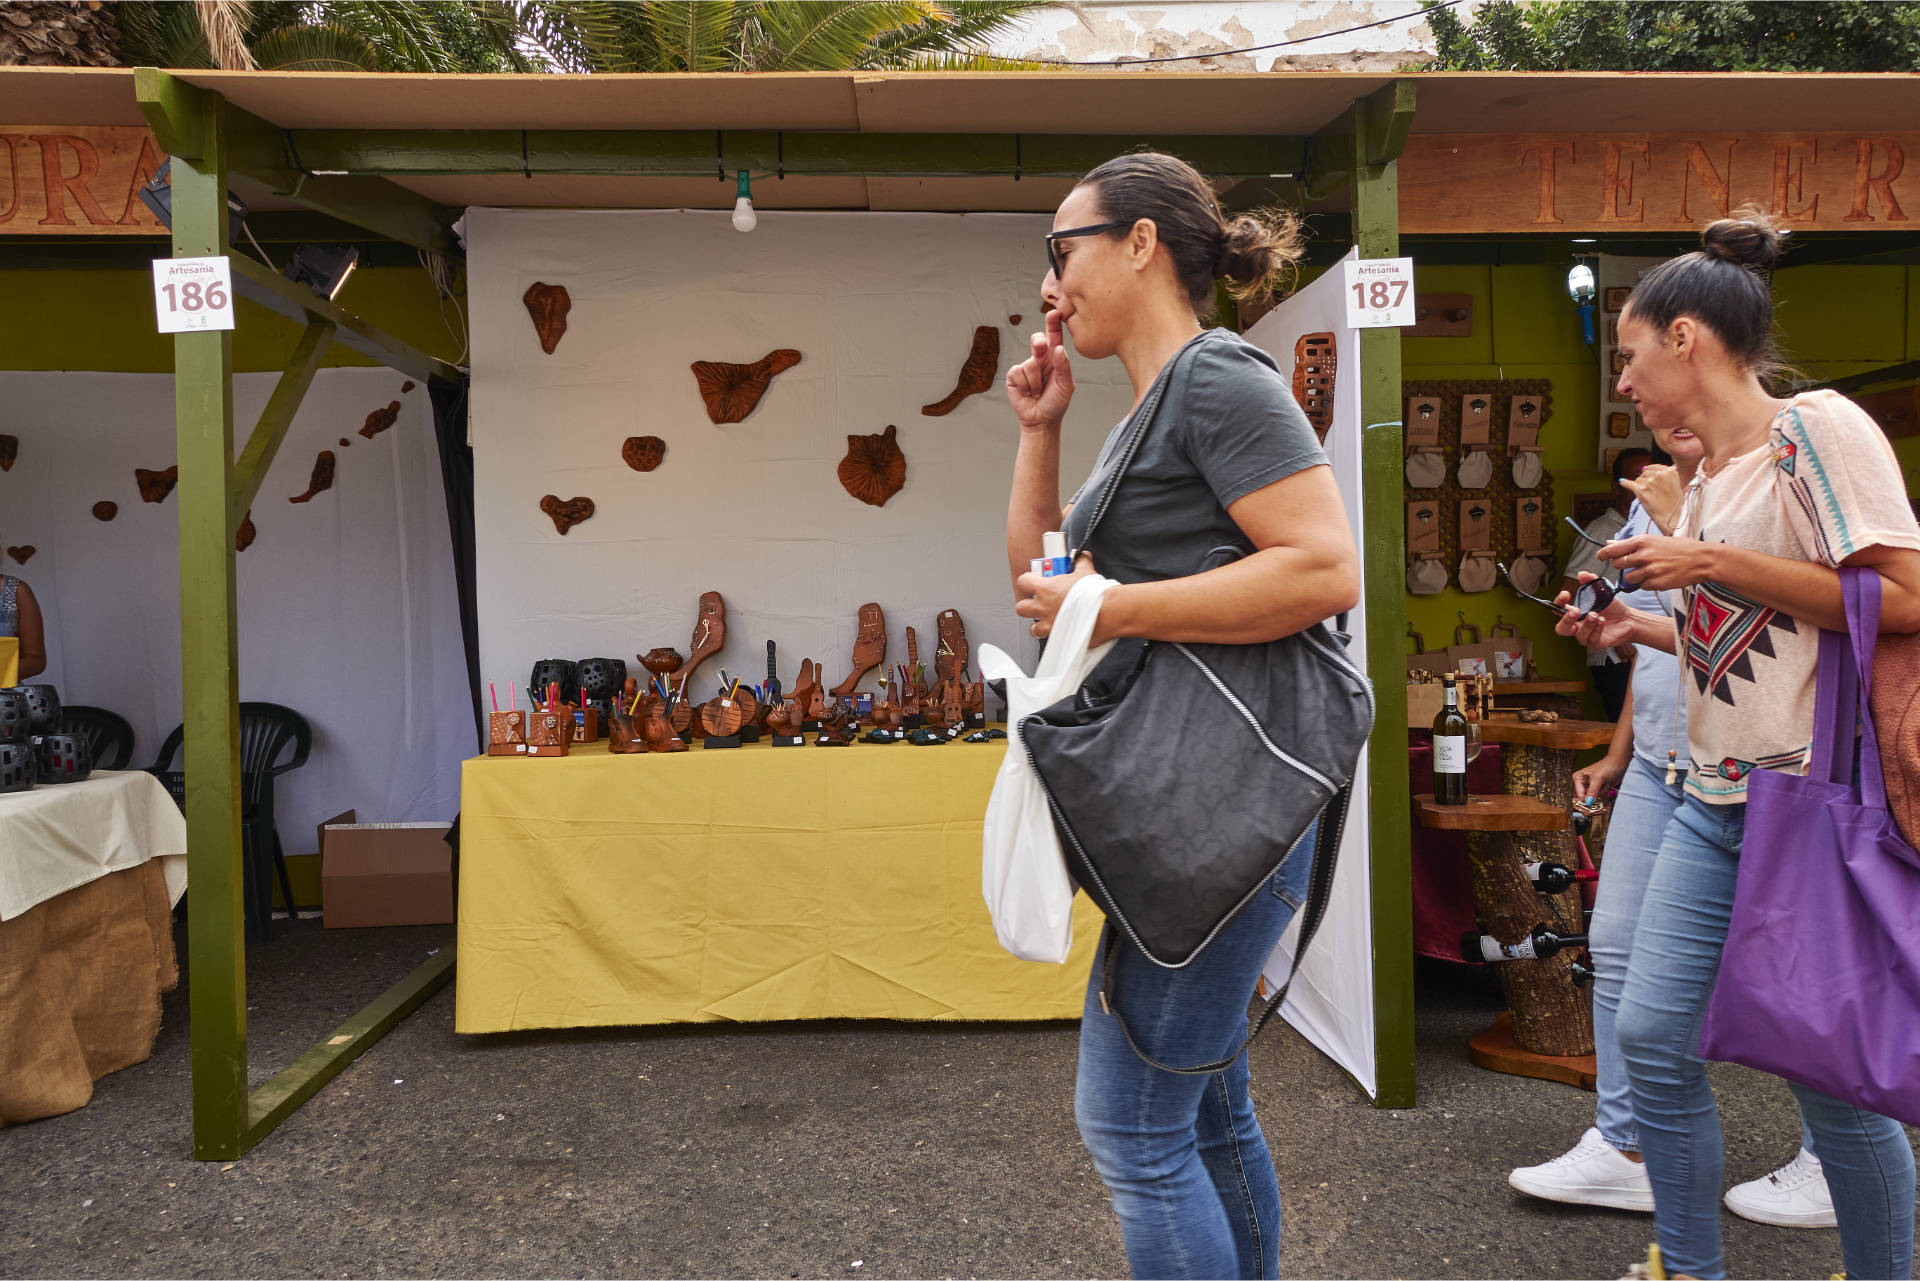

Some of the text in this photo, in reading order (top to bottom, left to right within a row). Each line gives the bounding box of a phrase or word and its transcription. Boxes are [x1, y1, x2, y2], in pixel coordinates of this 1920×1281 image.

[1518, 137, 1909, 224] TENER
[169, 265, 214, 275] Artesanía
[1358, 266, 1399, 275] Artesanía
[162, 281, 228, 312] 186
[1352, 280, 1409, 309] 187
